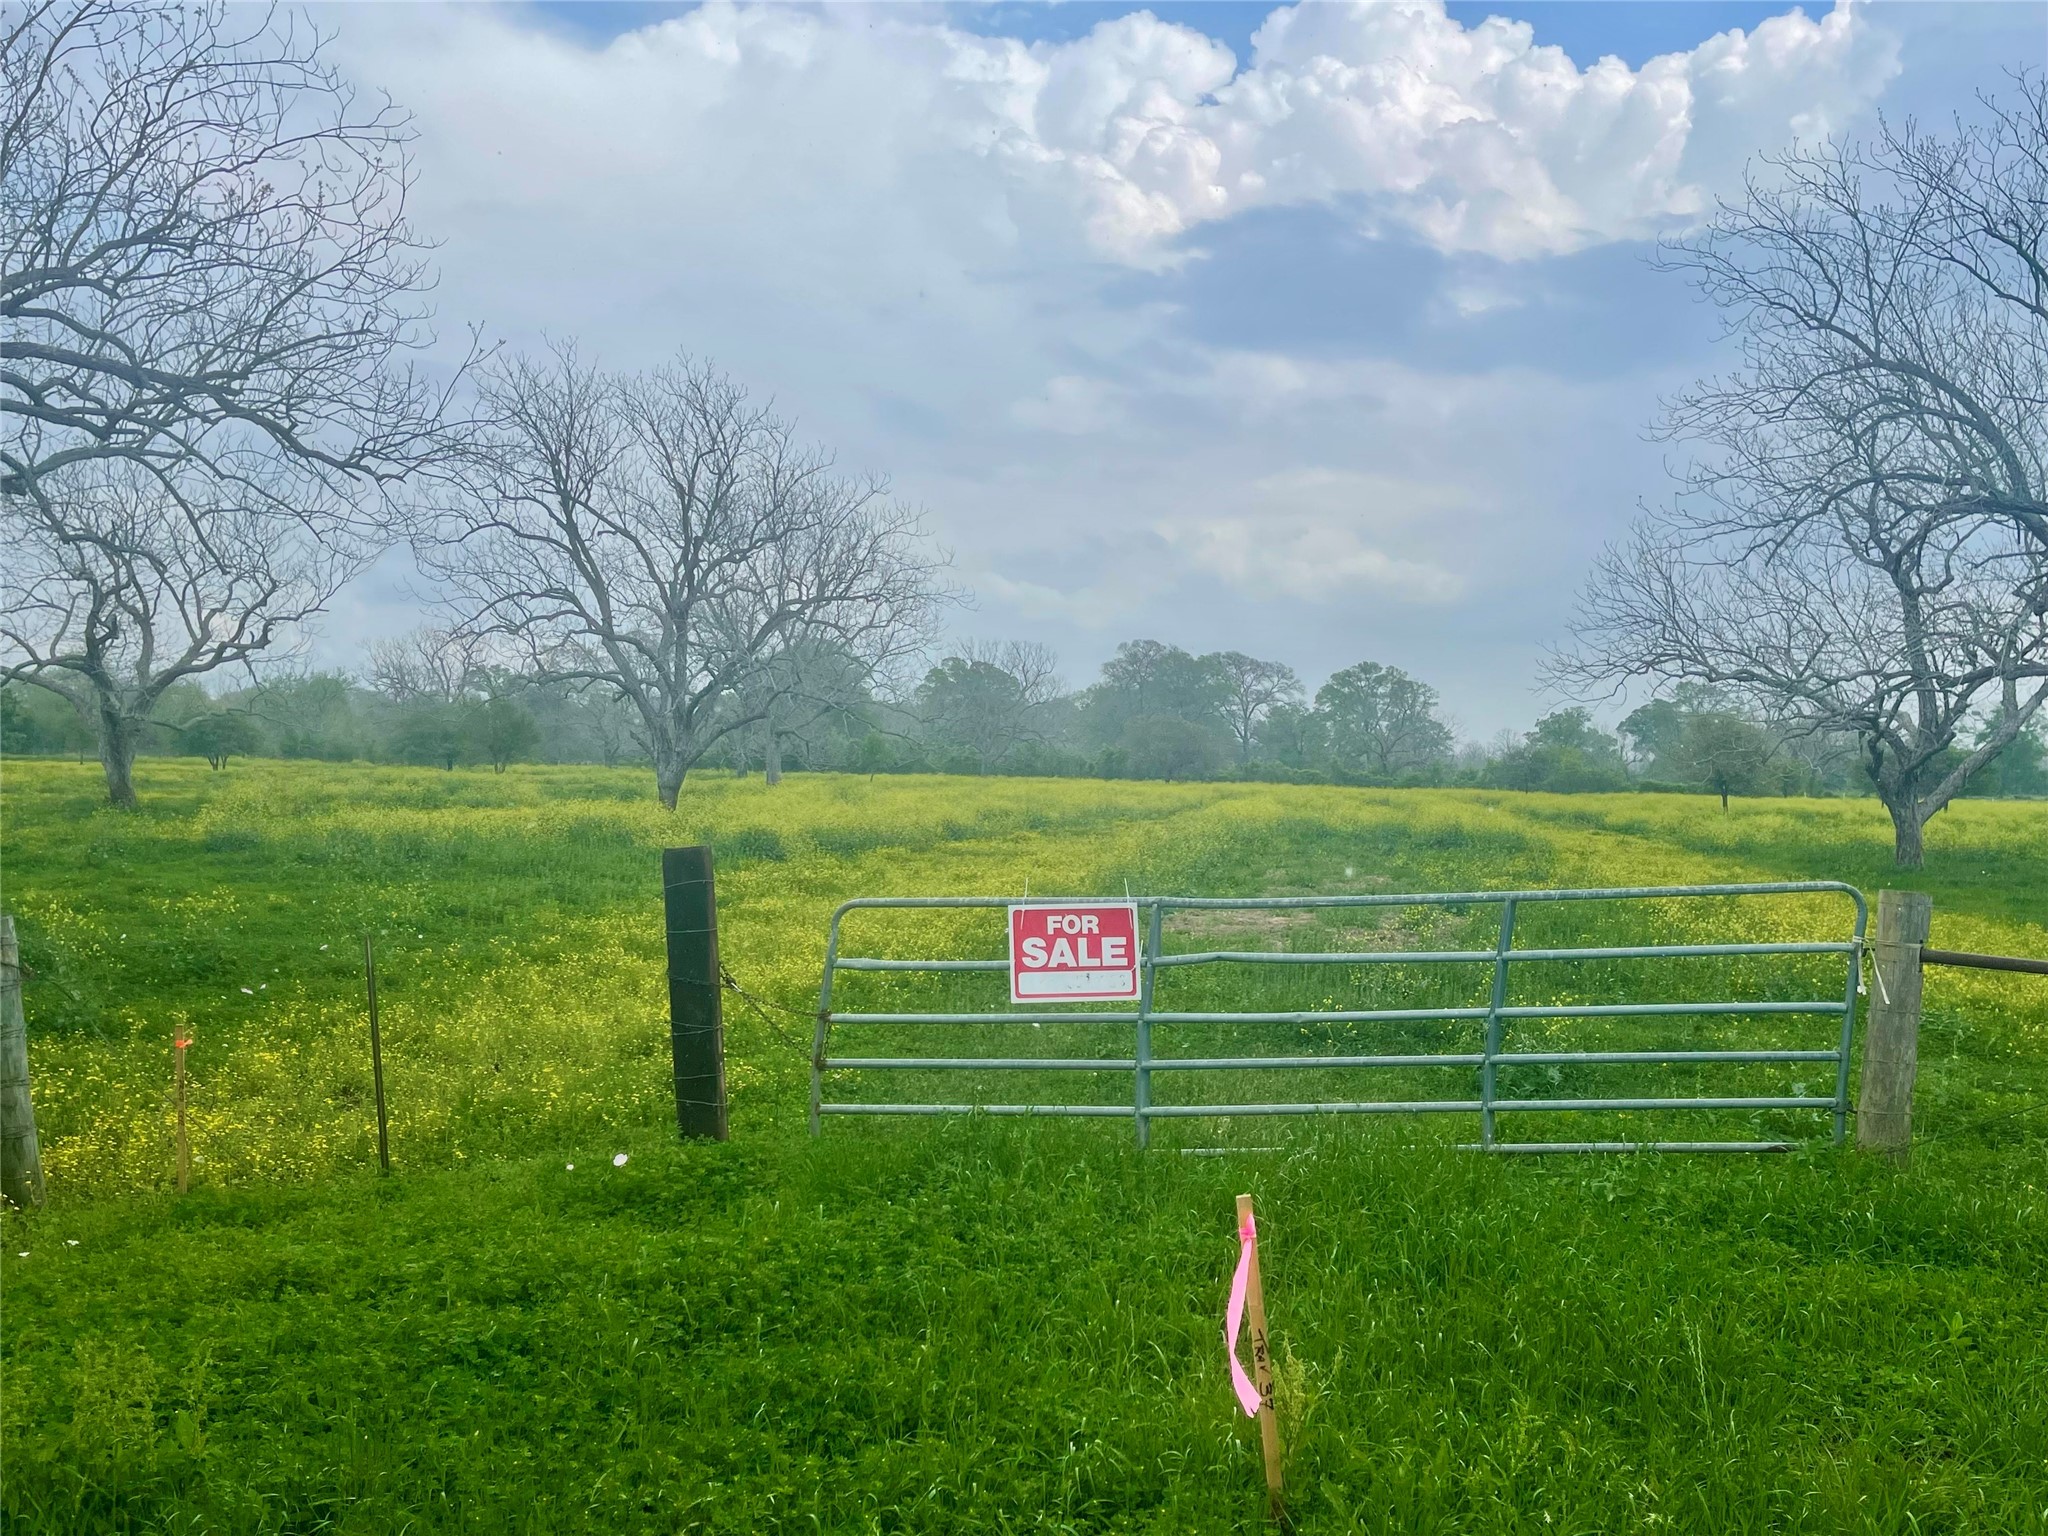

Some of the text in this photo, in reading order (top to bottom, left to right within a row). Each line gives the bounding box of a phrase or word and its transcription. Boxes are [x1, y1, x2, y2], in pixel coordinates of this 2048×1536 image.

[1046, 914, 1100, 935] FOR
[1021, 936, 1129, 968] SALE
[1259, 1381, 1275, 1410] 37
